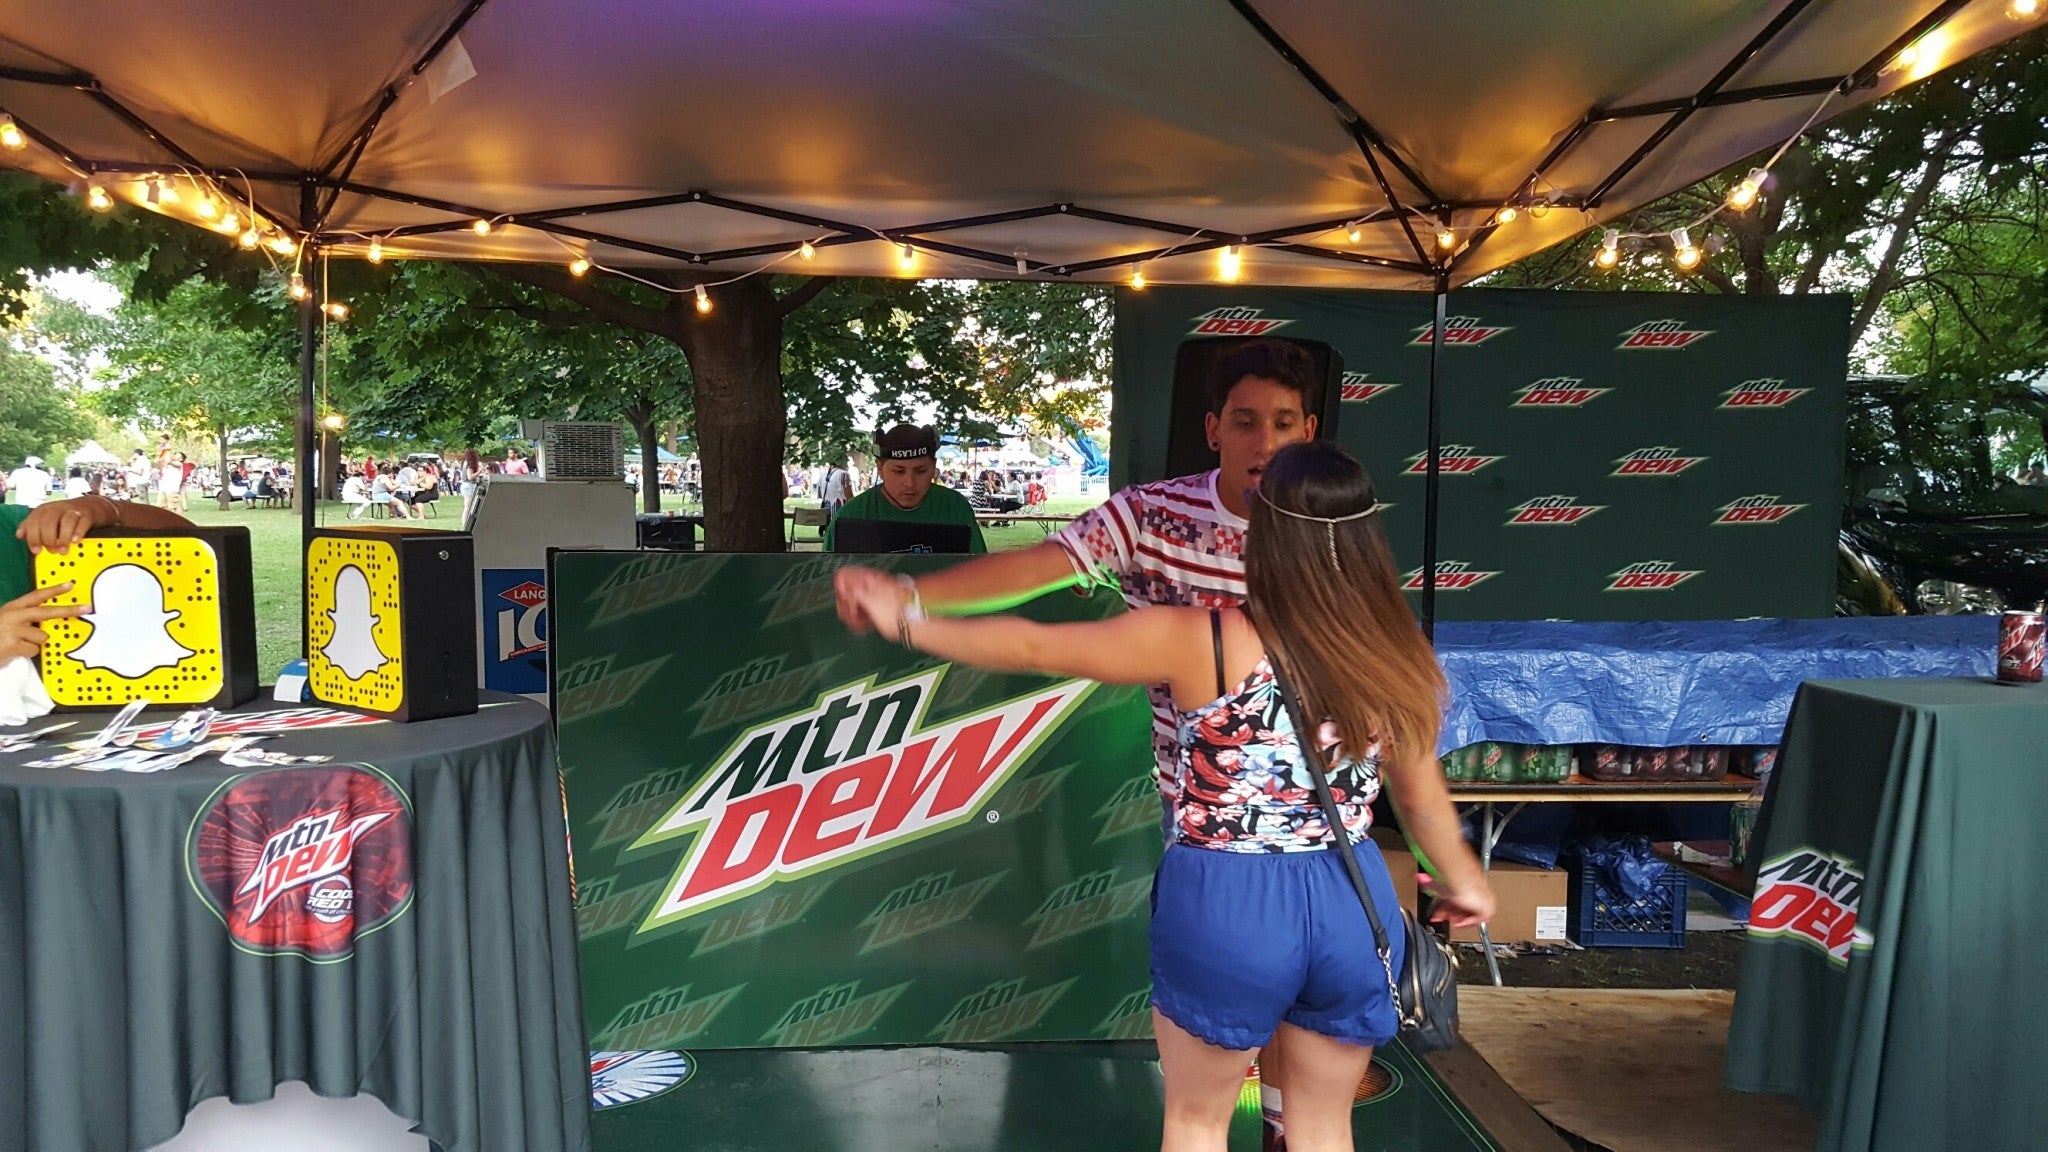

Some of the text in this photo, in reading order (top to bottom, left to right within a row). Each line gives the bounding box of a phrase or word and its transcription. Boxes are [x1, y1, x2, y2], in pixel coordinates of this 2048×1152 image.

[1203, 308, 1258, 319] Mtn
[1632, 320, 1682, 332] Mtn
[1528, 378, 1578, 389] Mtn
[1733, 379, 1780, 391] Mtn
[891, 447, 927, 458] DJ FLASH
[1625, 448, 1675, 459] Mtn
[1520, 497, 1571, 508] Mtn
[1726, 496, 1775, 507] Mtn
[1620, 562, 1670, 573] Mtn
[498, 601, 547, 661] IC
[684, 684, 922, 815] Mtn
[677, 693, 1067, 903] Dew
[258, 818, 330, 876] Mtn
[874, 876, 948, 917] Mtn
[1040, 874, 1112, 914] Mtn
[606, 991, 683, 1033] Mtn
[776, 987, 852, 1030] Mtn
[943, 983, 1018, 1025] Mtn
